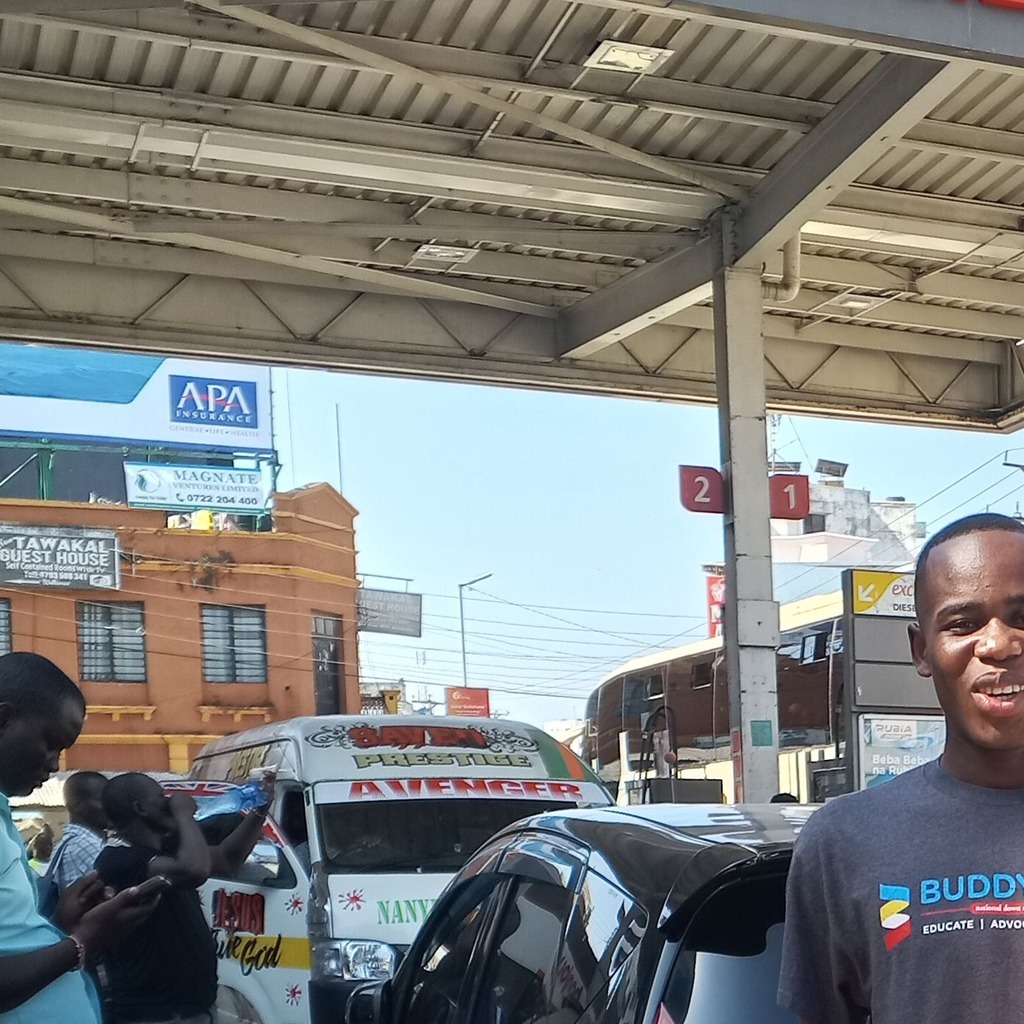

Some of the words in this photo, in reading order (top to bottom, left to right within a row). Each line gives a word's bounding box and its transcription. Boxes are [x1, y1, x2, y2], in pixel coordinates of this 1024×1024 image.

[176, 382, 250, 414] APA
[176, 410, 253, 423] INSURANCE
[173, 470, 259, 485] MAGNATE
[172, 482, 219, 491] VENTURES
[221, 485, 259, 493] LIMITED
[693, 476, 711, 503] 2
[187, 494, 213, 503] 0722
[216, 495, 235, 504] 204
[238, 497, 258, 505] 400
[783, 484, 796, 510] 1
[13, 536, 109, 553] TAWAKAL
[0, 549, 51, 563] GUEST
[56, 551, 109, 566] HOUSE
[6, 561, 19, 570] Self
[21, 562, 53, 571] Contained
[892, 584, 913, 597] exc
[360, 600, 384, 611] UEST
[893, 603, 916, 612] DIESE
[351, 752, 532, 769] PRESTIGE
[872, 754, 900, 765] Beba
[873, 767, 886, 775] na
[349, 778, 583, 800] AVENGER
[376, 898, 437, 925] NANY
[922, 919, 974, 935] EDUCATE
